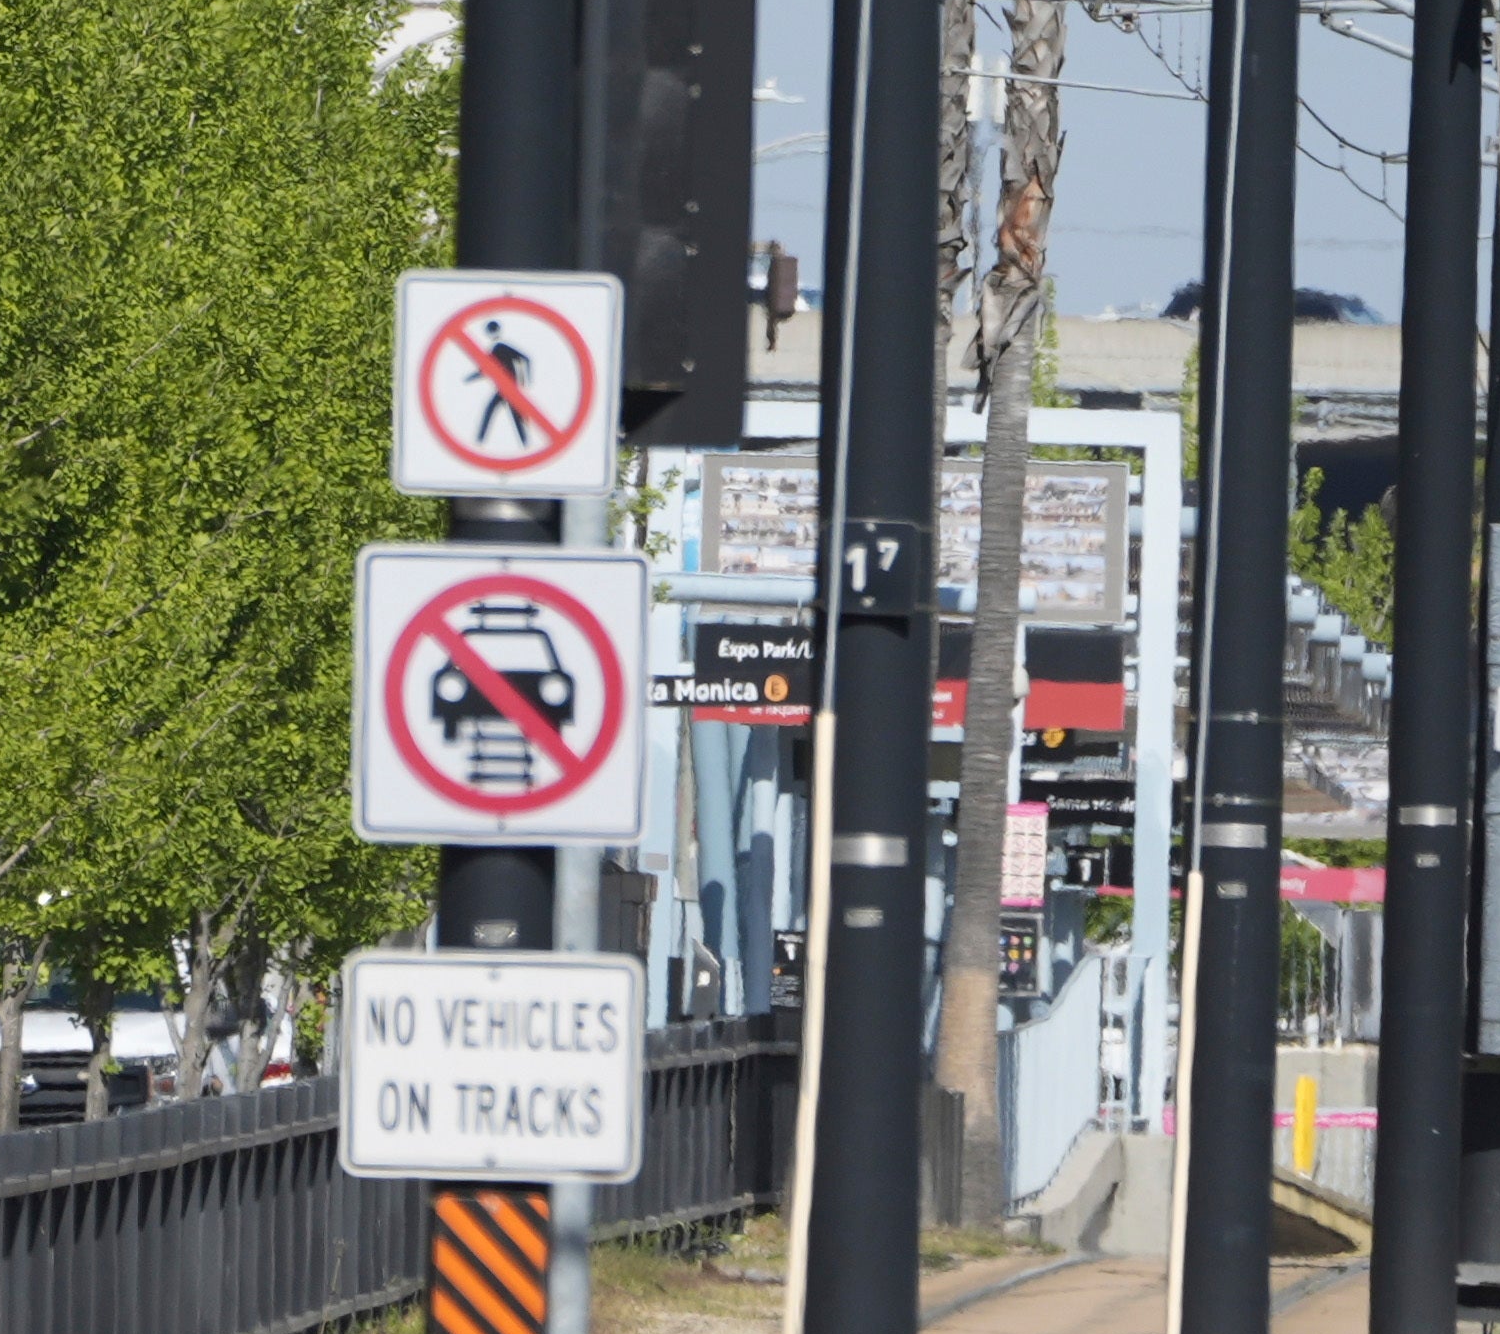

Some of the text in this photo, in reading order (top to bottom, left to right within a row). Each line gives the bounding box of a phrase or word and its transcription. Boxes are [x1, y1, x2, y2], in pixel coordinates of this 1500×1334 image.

[718, 638, 760, 663] Expo
[674, 677, 759, 703] Monica
[366, 995, 618, 1053] NO VEHICLES
[378, 1080, 603, 1138] ON TRACKS
